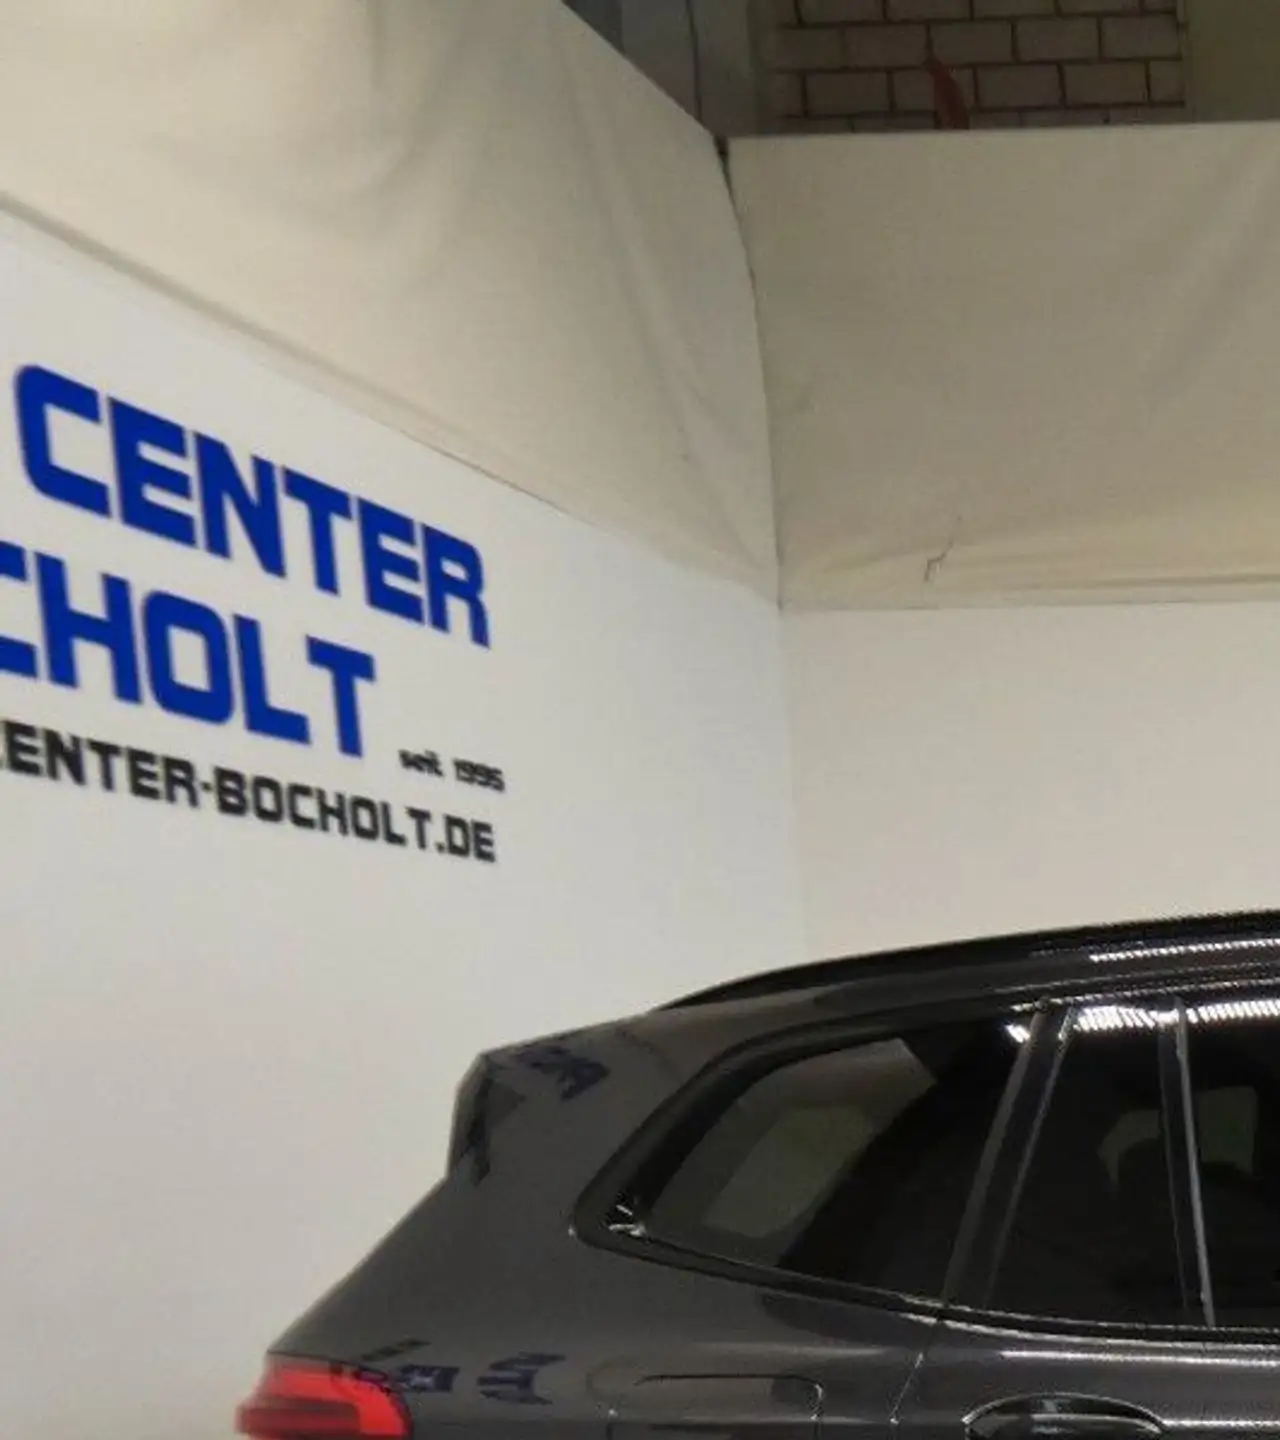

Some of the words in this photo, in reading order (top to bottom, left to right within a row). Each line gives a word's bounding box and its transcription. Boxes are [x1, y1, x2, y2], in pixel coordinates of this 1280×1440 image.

[14, 364, 490, 647] CENTER
[0, 717, 497, 865] ENTER-BOCHOLT.DE
[398, 749, 444, 778] seit
[453, 757, 506, 793] 1995
